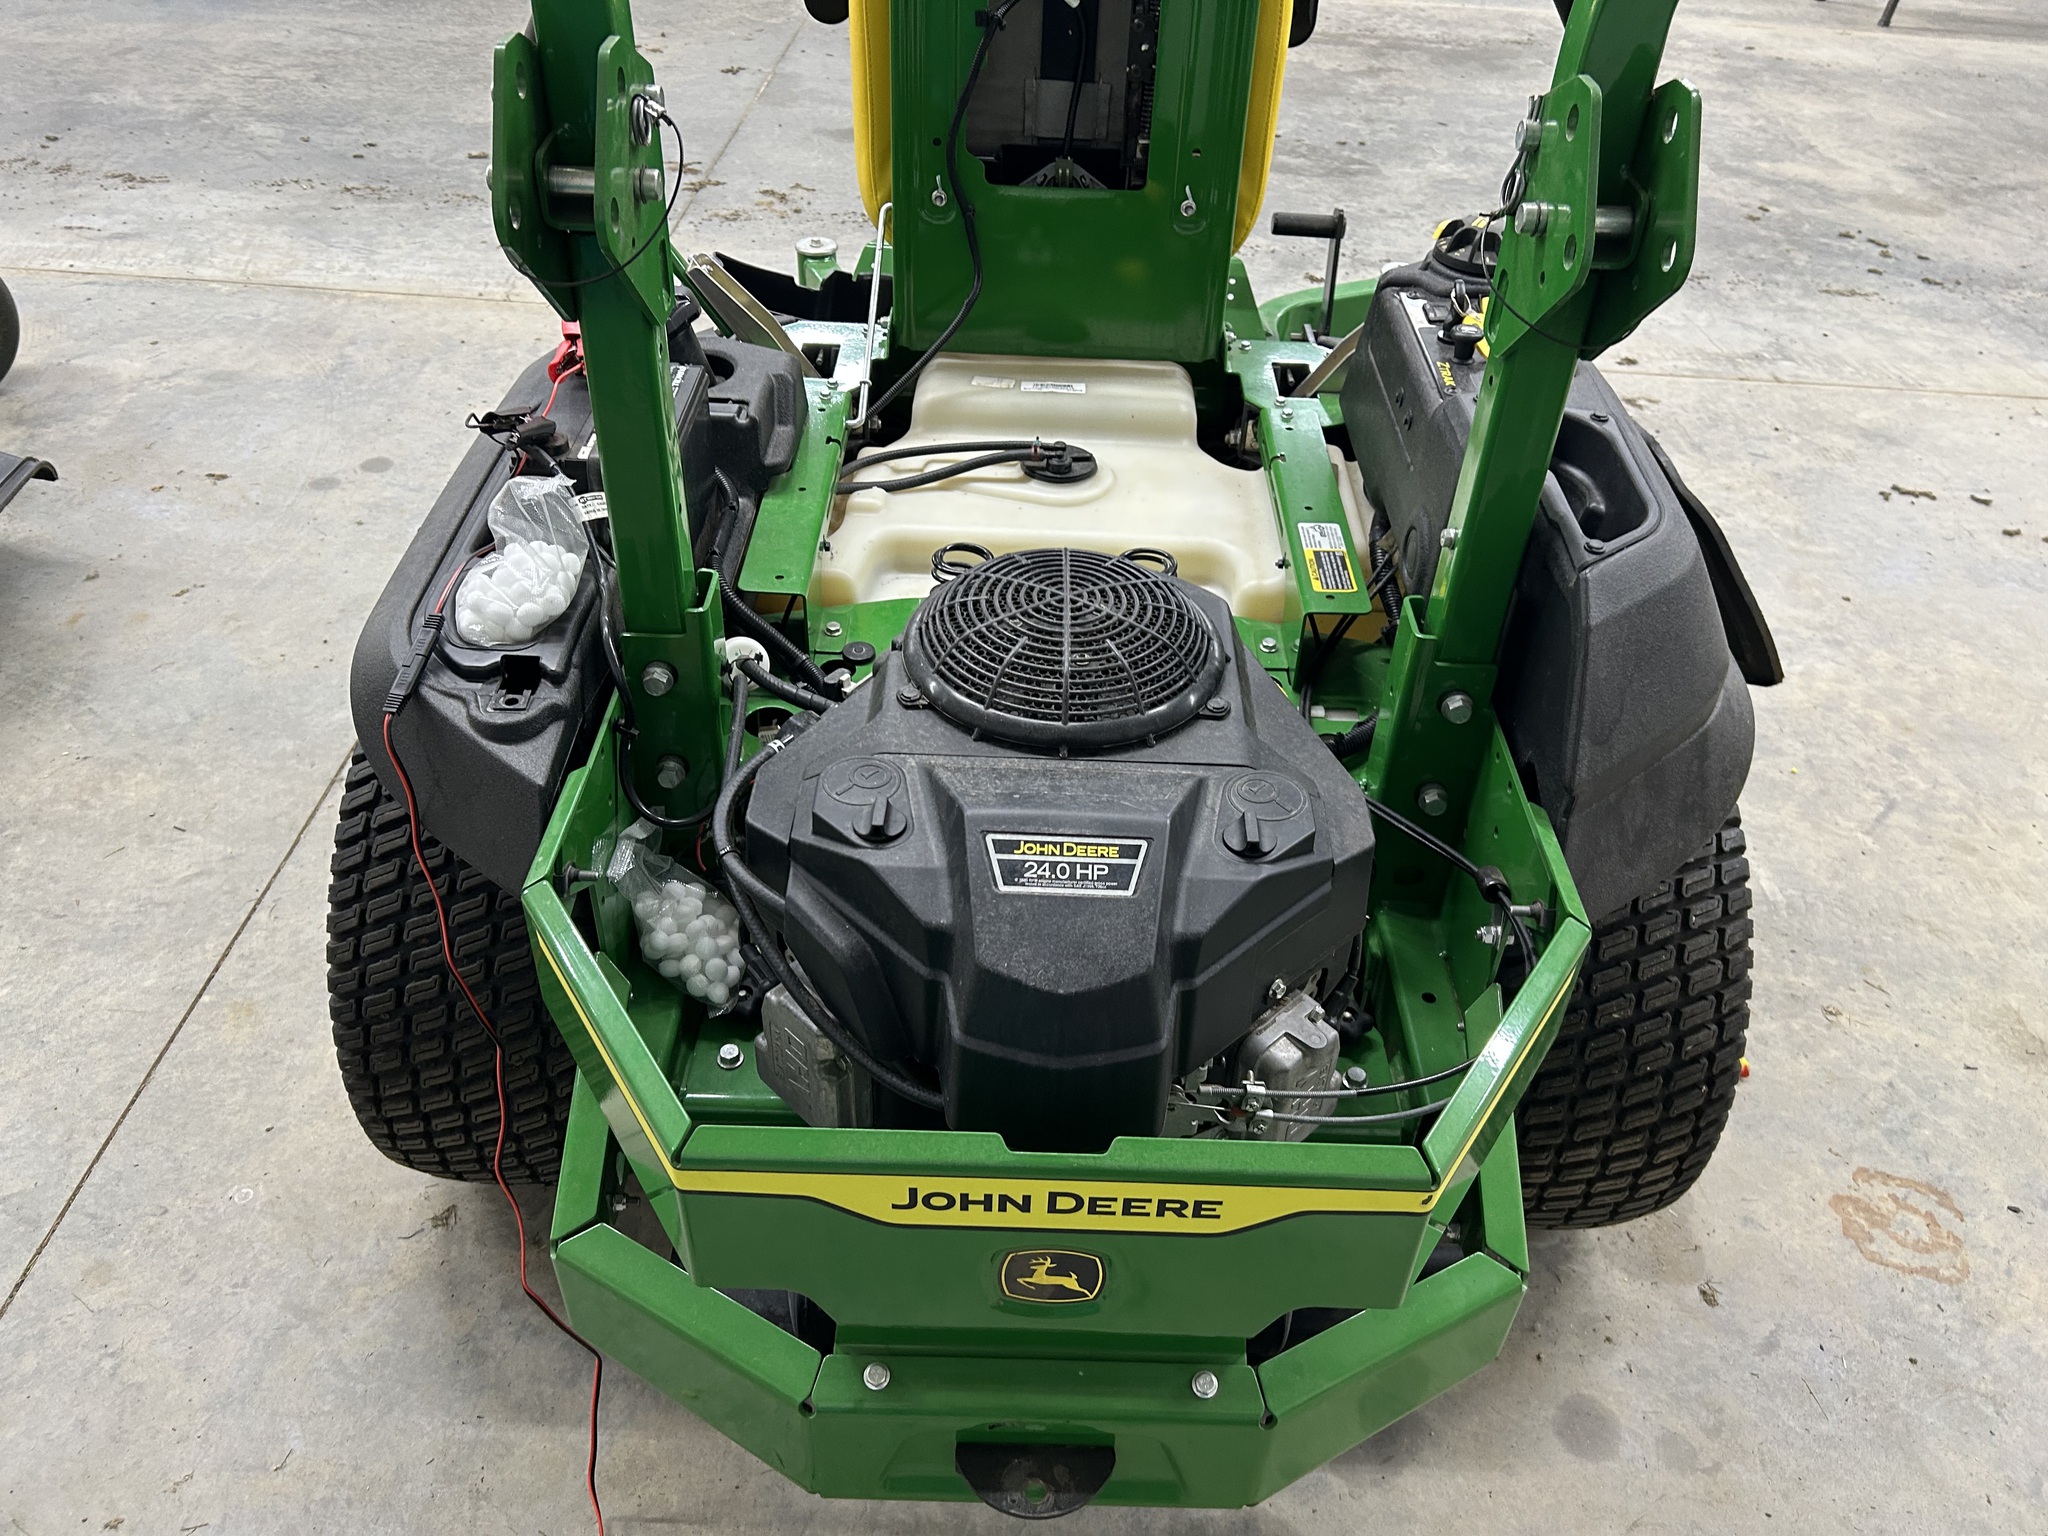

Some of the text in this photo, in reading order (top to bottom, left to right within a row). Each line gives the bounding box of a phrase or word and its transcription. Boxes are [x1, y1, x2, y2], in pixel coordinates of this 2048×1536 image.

[1436, 361, 1456, 387] ZTRAK
[1013, 840, 1119, 858] JOHN DEERE
[1023, 861, 1109, 880] 24.0 HP
[891, 1187, 1224, 1219] JOHN DEERE
